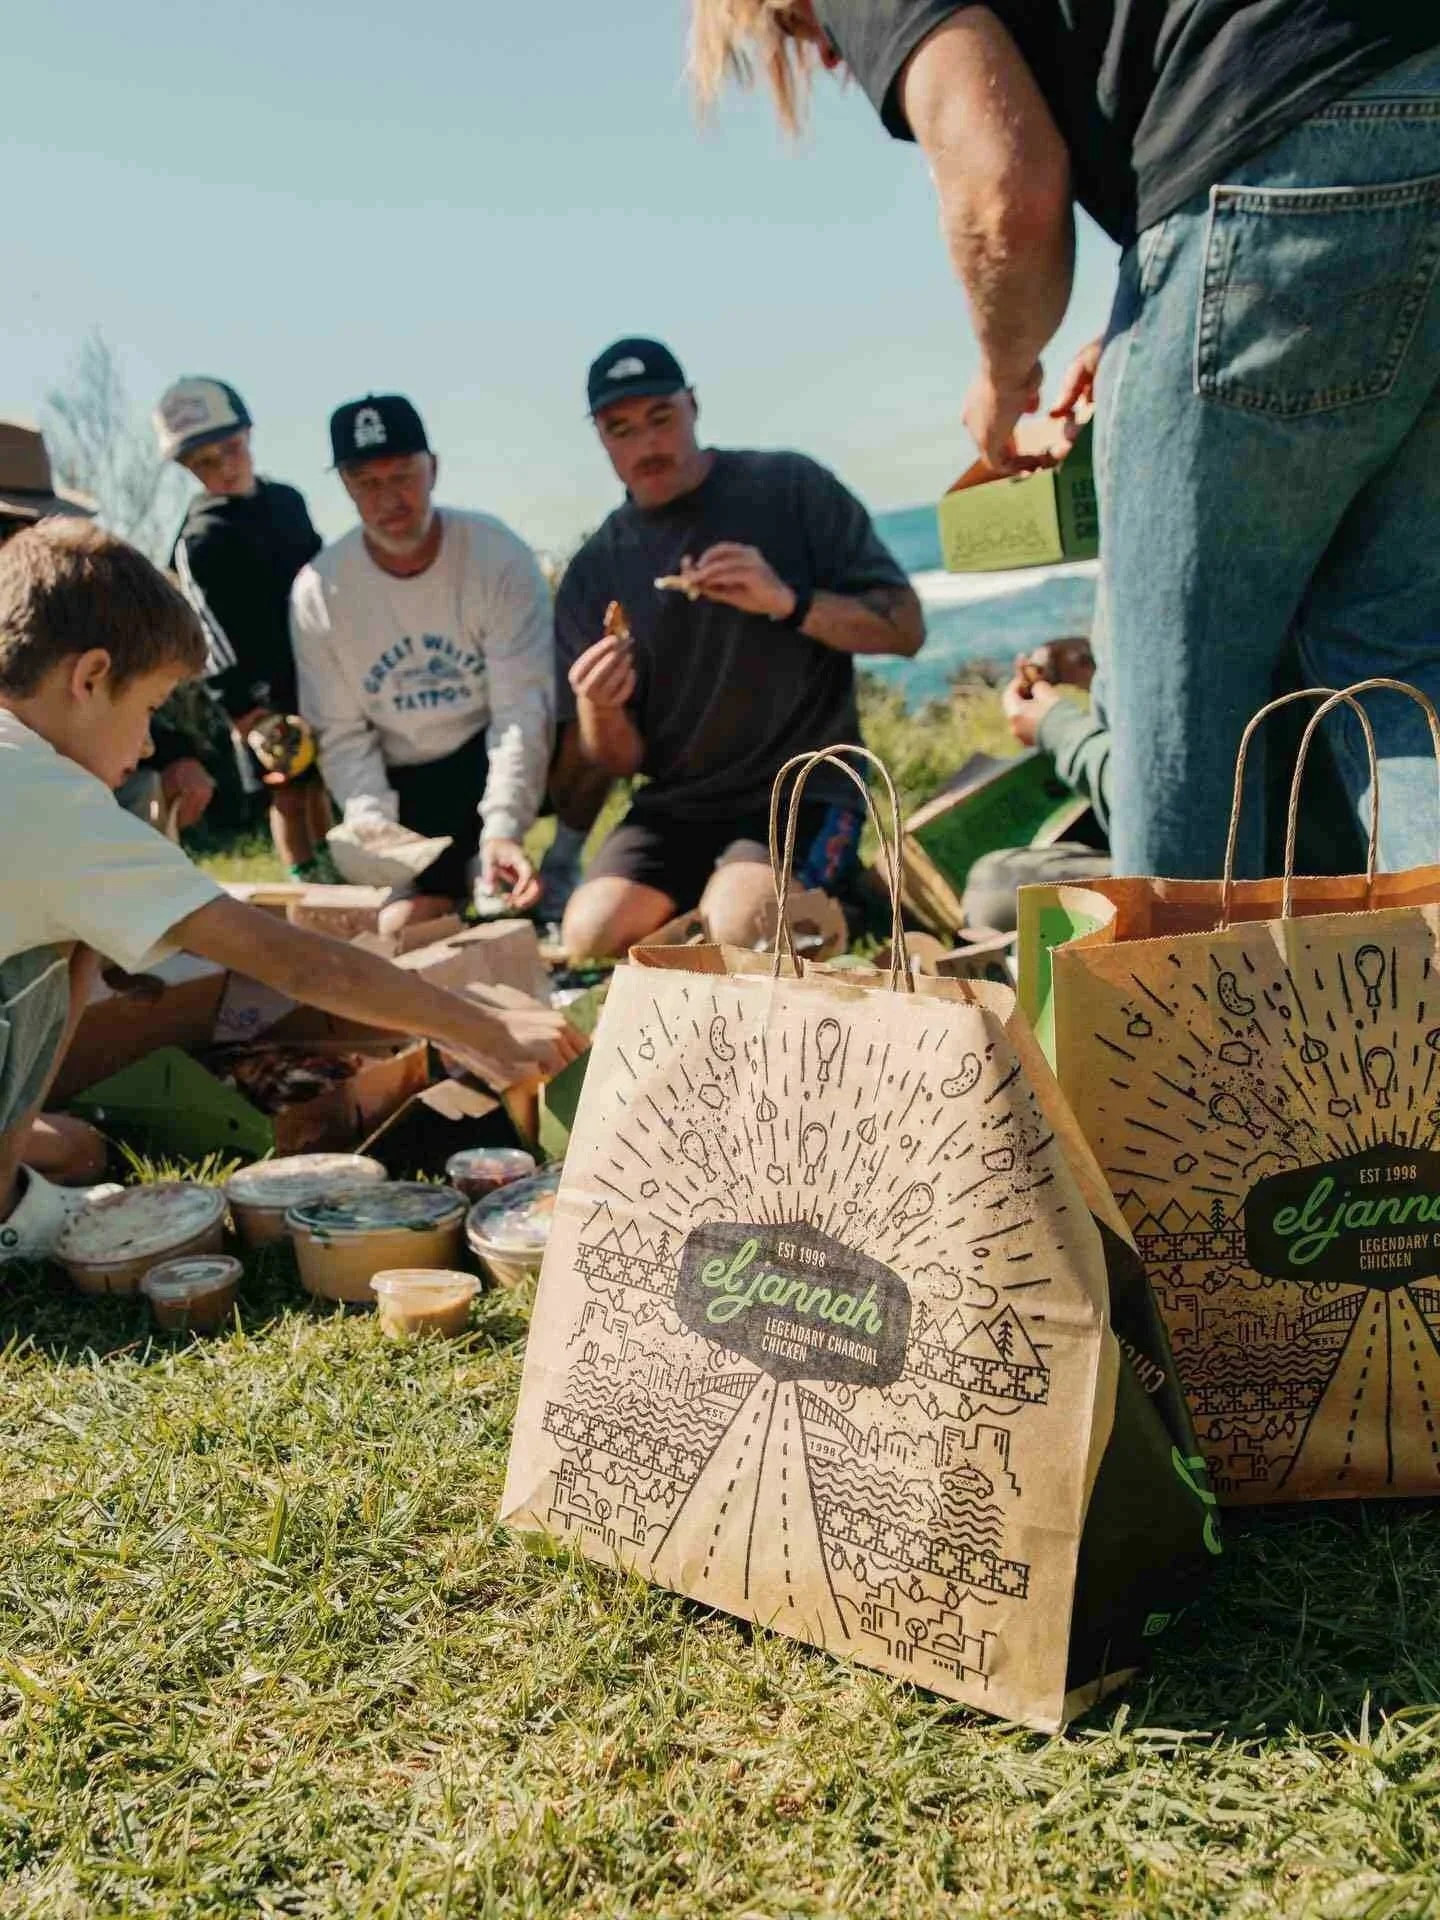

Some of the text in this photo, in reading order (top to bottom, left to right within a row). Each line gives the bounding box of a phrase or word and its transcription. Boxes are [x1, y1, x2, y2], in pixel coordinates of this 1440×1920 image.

[363, 635, 414, 694] GREAT
[1360, 1164, 1417, 1184] EST 1998
[777, 1240, 826, 1268] EST 1998
[1359, 1232, 1429, 1254] LEGENDARY
[1359, 1252, 1412, 1271] CHICKEN
[761, 1333, 808, 1362] CHICKEN
[765, 1316, 879, 1367] LEGENDARY CHARCOAL
[809, 1440, 836, 1457] 1998
